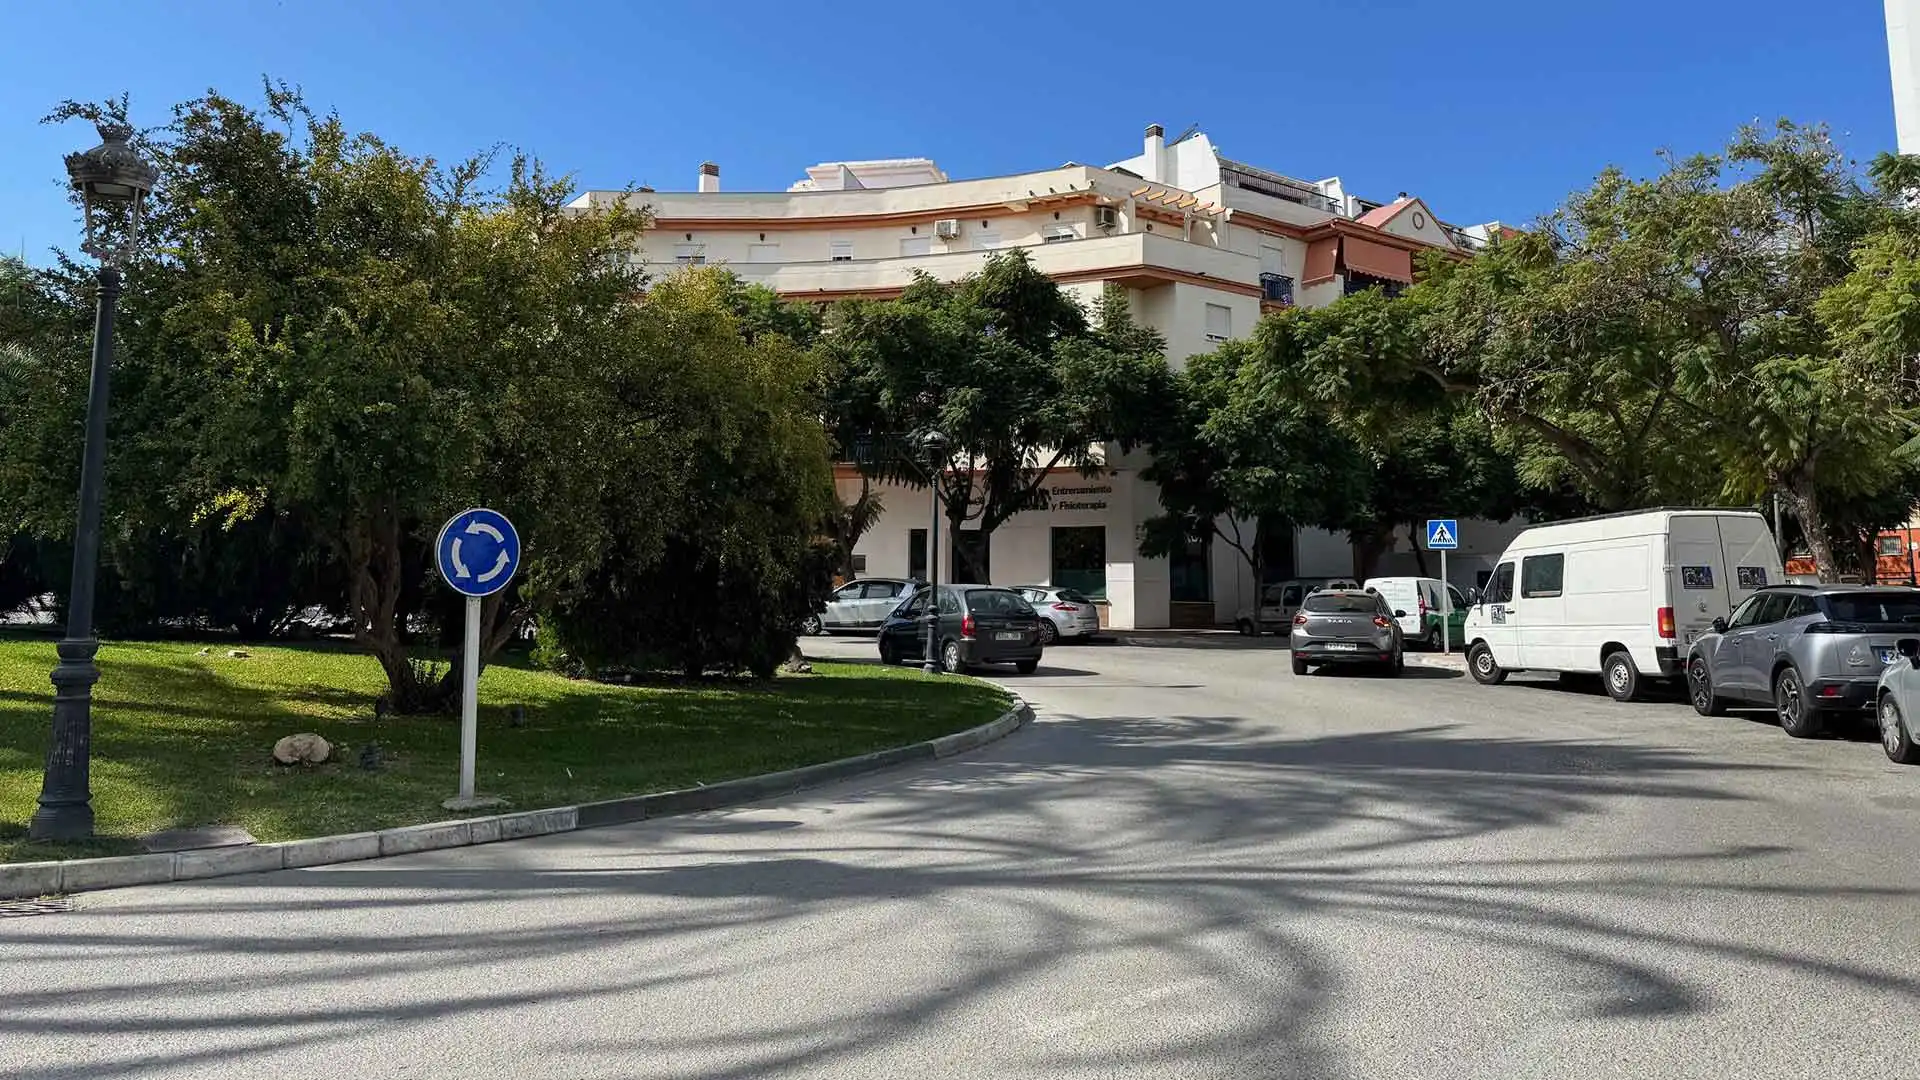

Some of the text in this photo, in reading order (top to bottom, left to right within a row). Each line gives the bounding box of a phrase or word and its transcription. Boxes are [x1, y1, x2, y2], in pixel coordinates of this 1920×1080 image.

[1052, 485, 1112, 495] Entrenamiento
[1051, 503, 1057, 512] y
[1059, 500, 1107, 511] Fisioterapia
